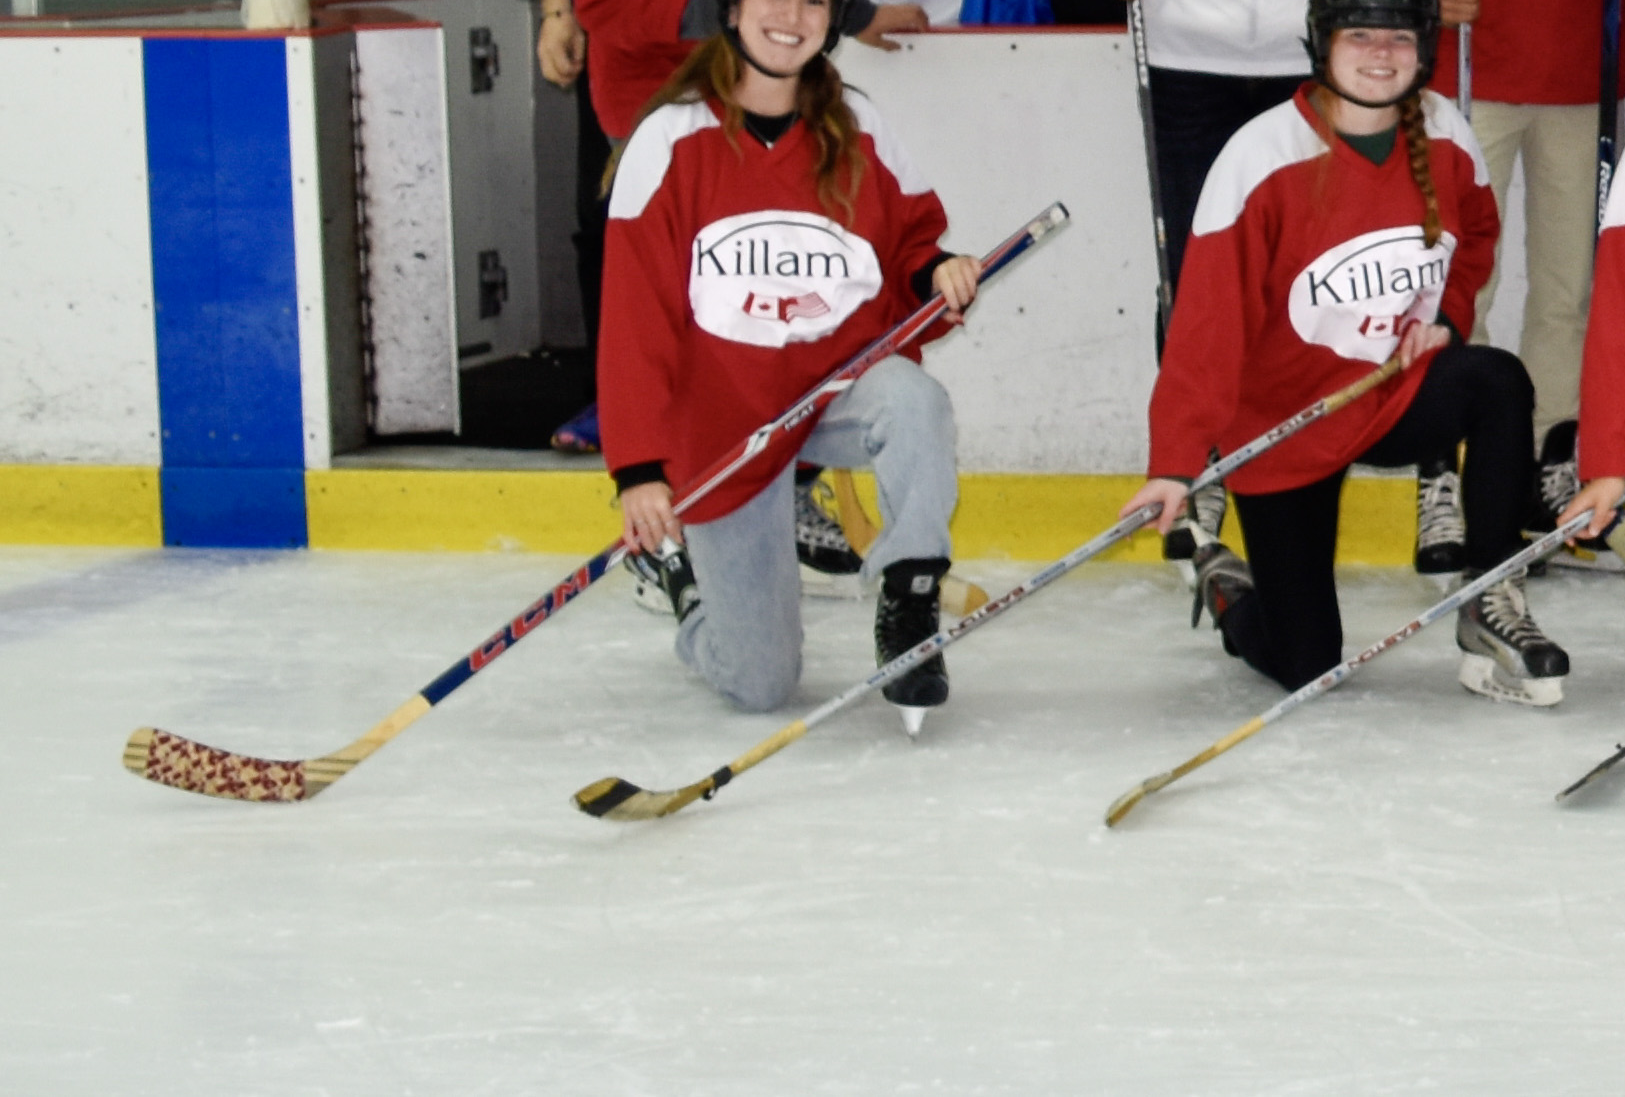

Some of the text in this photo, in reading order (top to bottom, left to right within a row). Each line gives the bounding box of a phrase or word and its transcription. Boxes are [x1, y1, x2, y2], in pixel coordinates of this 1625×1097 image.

[696, 238, 850, 279] Killam
[1308, 257, 1446, 308] Killam
[1266, 401, 1326, 443] ASTON
[468, 565, 592, 673] CCM
